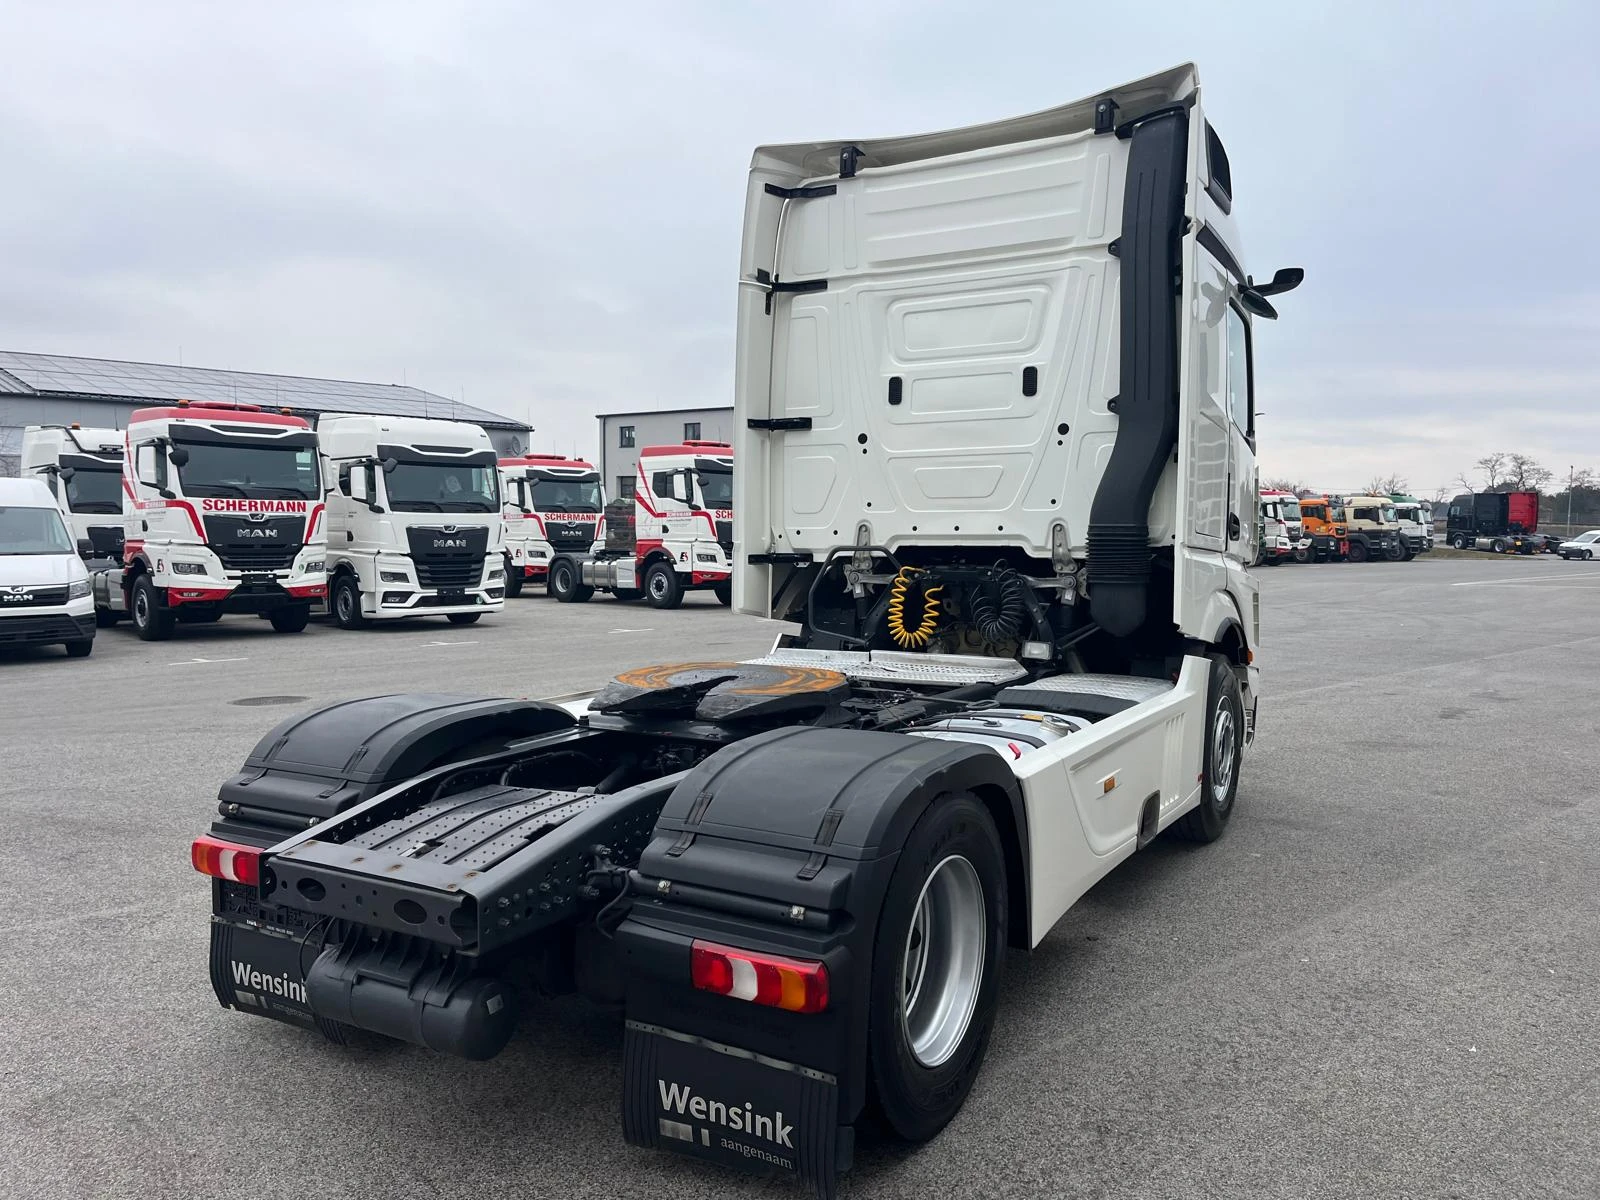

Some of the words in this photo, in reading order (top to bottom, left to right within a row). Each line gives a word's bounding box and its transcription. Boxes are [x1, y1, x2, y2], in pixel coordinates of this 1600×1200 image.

[203, 499, 306, 512] SCHERMANN
[544, 513, 597, 521] SCHERMANN
[237, 529, 278, 538] MAN
[433, 539, 467, 548] MAN
[3, 594, 33, 602] MAN
[658, 1079, 794, 1149] Wensink
[720, 1137, 793, 1170] aangenaam
